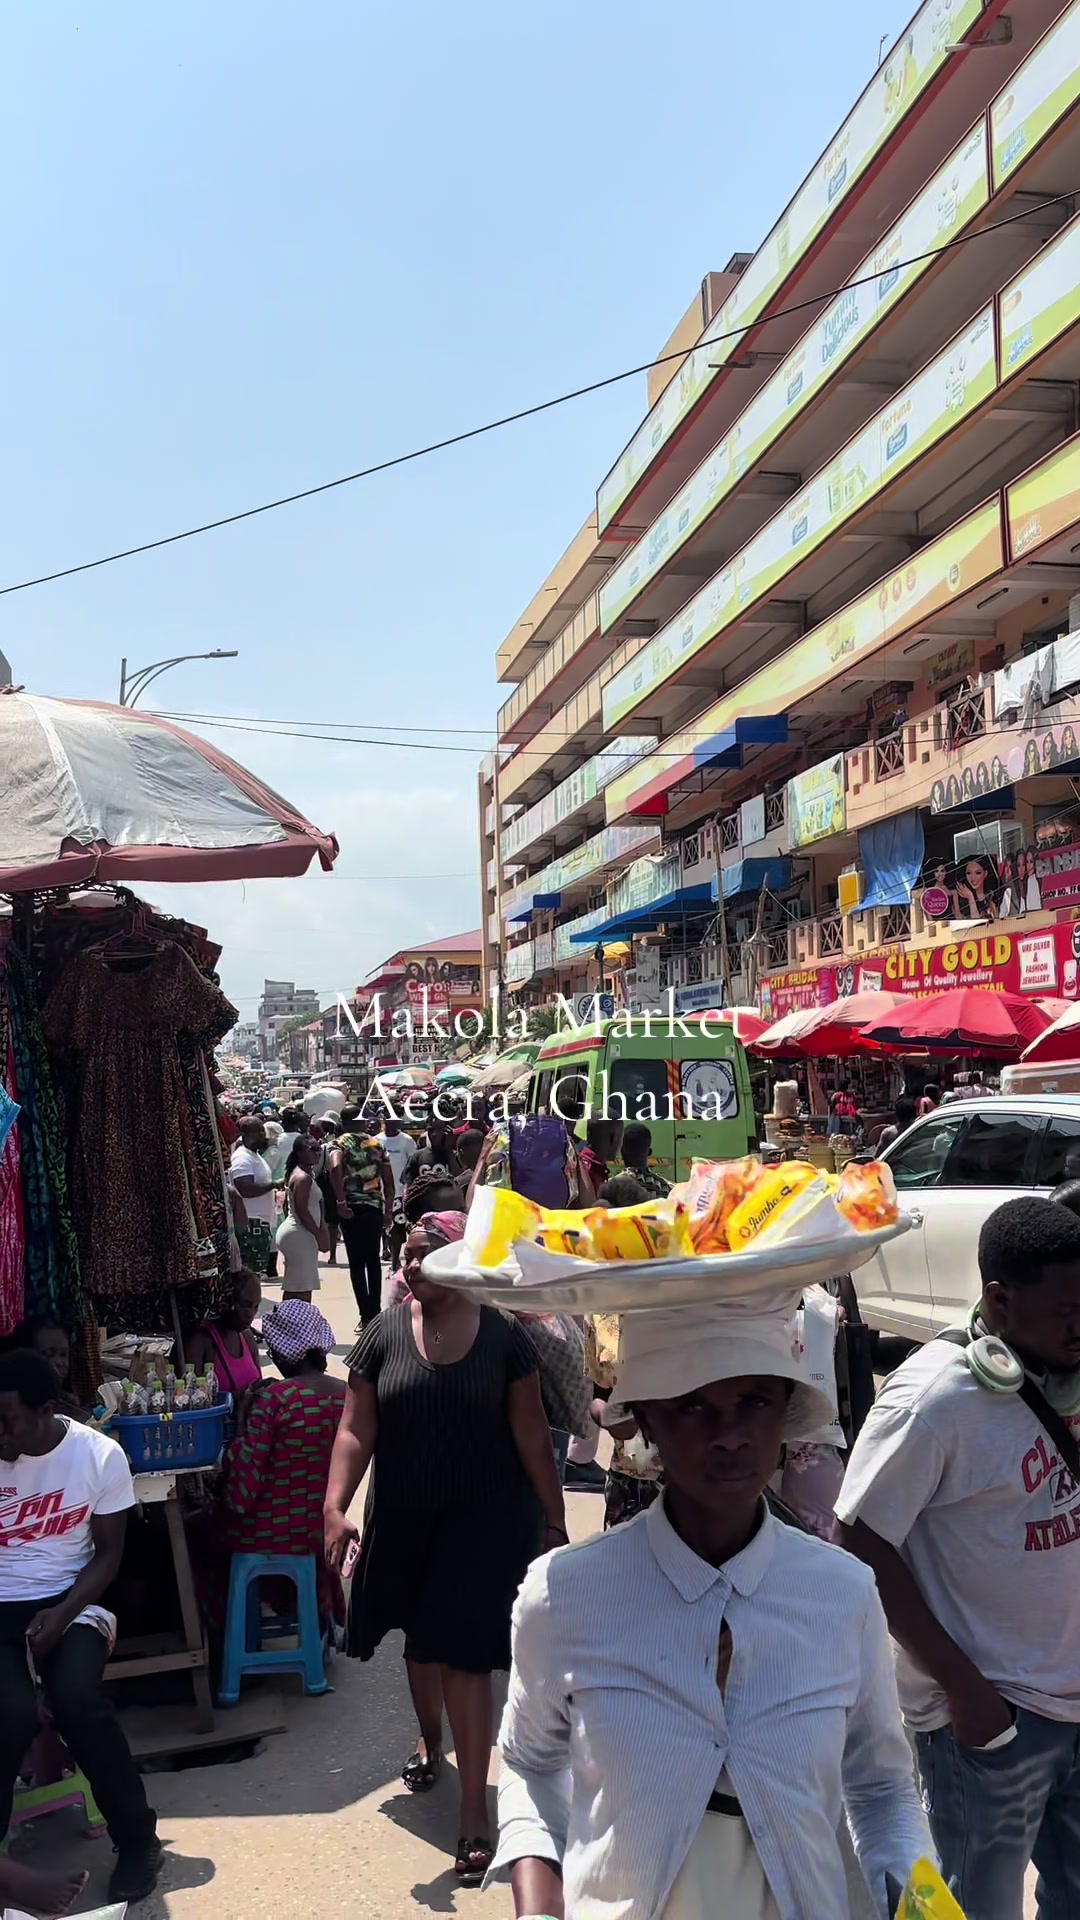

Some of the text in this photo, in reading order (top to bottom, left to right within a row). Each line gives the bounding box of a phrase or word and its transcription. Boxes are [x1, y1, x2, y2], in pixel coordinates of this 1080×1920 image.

[822, 306, 859, 362] Delicious
[1033, 940, 1050, 951] SILVER
[886, 935, 1012, 979] CITY GOLD
[1033, 952, 1038, 963] &
[1026, 963, 1049, 974] FASHION
[902, 978, 920, 990] Home
[933, 972, 958, 986] Quality
[960, 968, 993, 983] Jewellery
[1022, 974, 1050, 985] JEWELLERY
[412, 1044, 433, 1053] BEST
[748, 1198, 779, 1232] Jumbo
